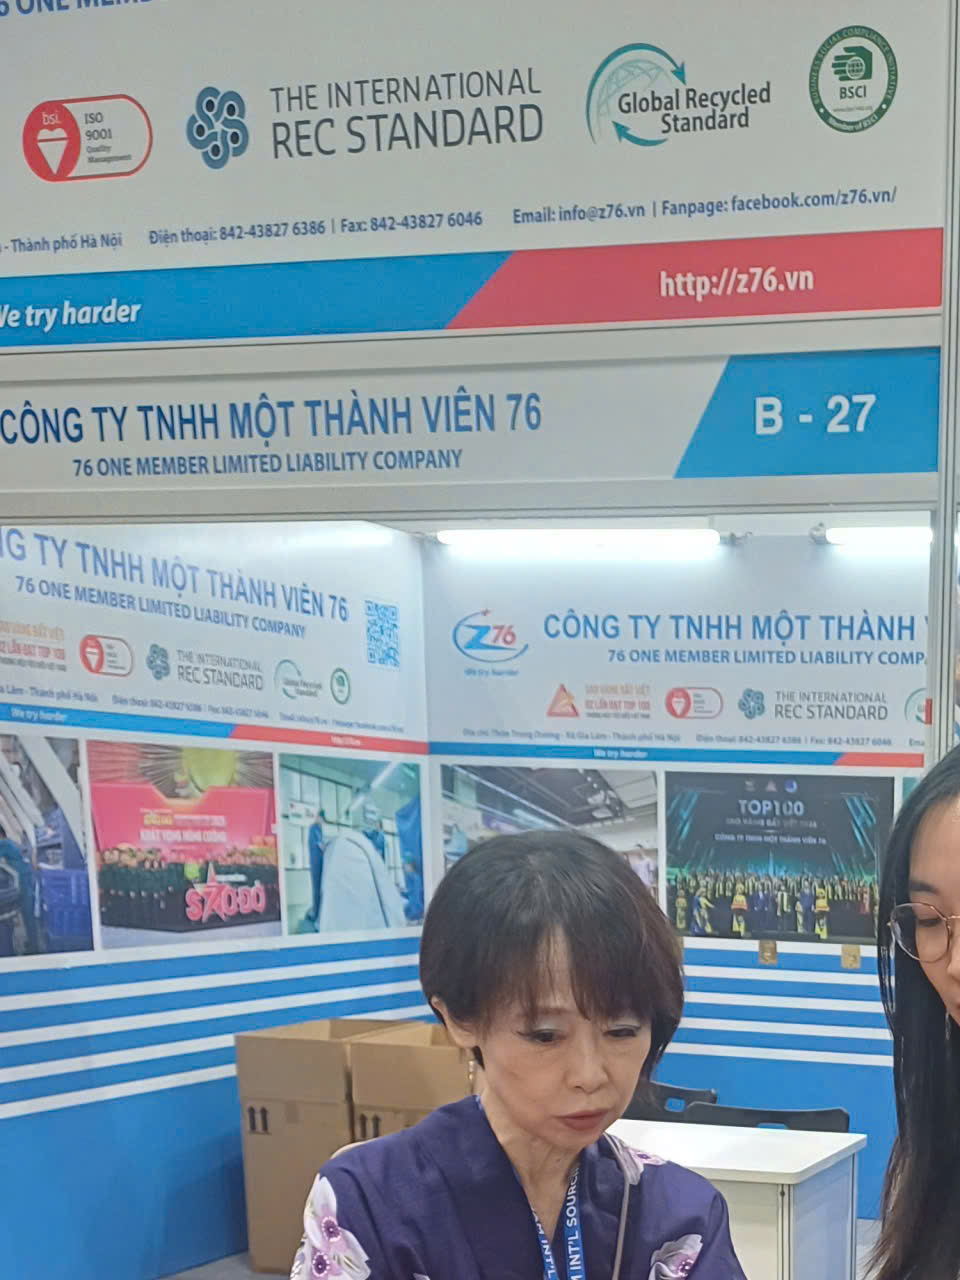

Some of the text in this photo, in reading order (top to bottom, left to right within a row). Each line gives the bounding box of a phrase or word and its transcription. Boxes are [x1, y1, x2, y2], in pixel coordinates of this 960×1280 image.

[270, 67, 541, 113] THE INTERNATIONAL
[618, 81, 771, 114] Global Recycled
[840, 85, 867, 99] BSCI
[84, 112, 104, 124] ISO
[86, 129, 112, 140] 9001
[273, 104, 544, 159] REC STANDARD
[661, 107, 749, 134] Standard
[219, 222, 288, 241] 842-43827
[340, 217, 368, 234] Fax:
[370, 213, 443, 231] 842-43827
[448, 211, 483, 227] 6046
[513, 207, 556, 225] Email:
[558, 201, 645, 222] info@z76.vn
[661, 197, 728, 218] Fanpage:
[731, 186, 897, 212] facebook.com/z76.vn/
[660, 267, 814, 301] http://z76.vn
[25, 298, 141, 333] try harder
[1, 386, 542, 447] CÔNG TY TNHH MỘT THÀNH VIÊN 76
[755, 394, 876, 435] B 27
[73, 448, 463, 477] 76 ONE MEMBER LIMITED LIABILITY COMPANY
[33, 532, 68, 569] TY
[75, 541, 145, 585] TNHH
[151, 556, 200, 597] MỘT
[206, 567, 277, 609] THÀNH
[281, 582, 324, 618] VIÊN
[329, 594, 349, 622] 76
[15, 575, 306, 639] 76 ONE MEMBER LIMITED LIABILITY COMPANY
[544, 608, 915, 647] CÔNG TY TNHH MỘT THÀNH
[607, 650, 626, 663] 76
[630, 650, 660, 663] ONE
[664, 650, 730, 664] MEMBER
[735, 650, 796, 664] LIMITED
[800, 650, 873, 665] LIABILITY
[178, 666, 200, 685] REC
[203, 669, 264, 692] STANDARD
[774, 704, 888, 721] REC STANDARD
